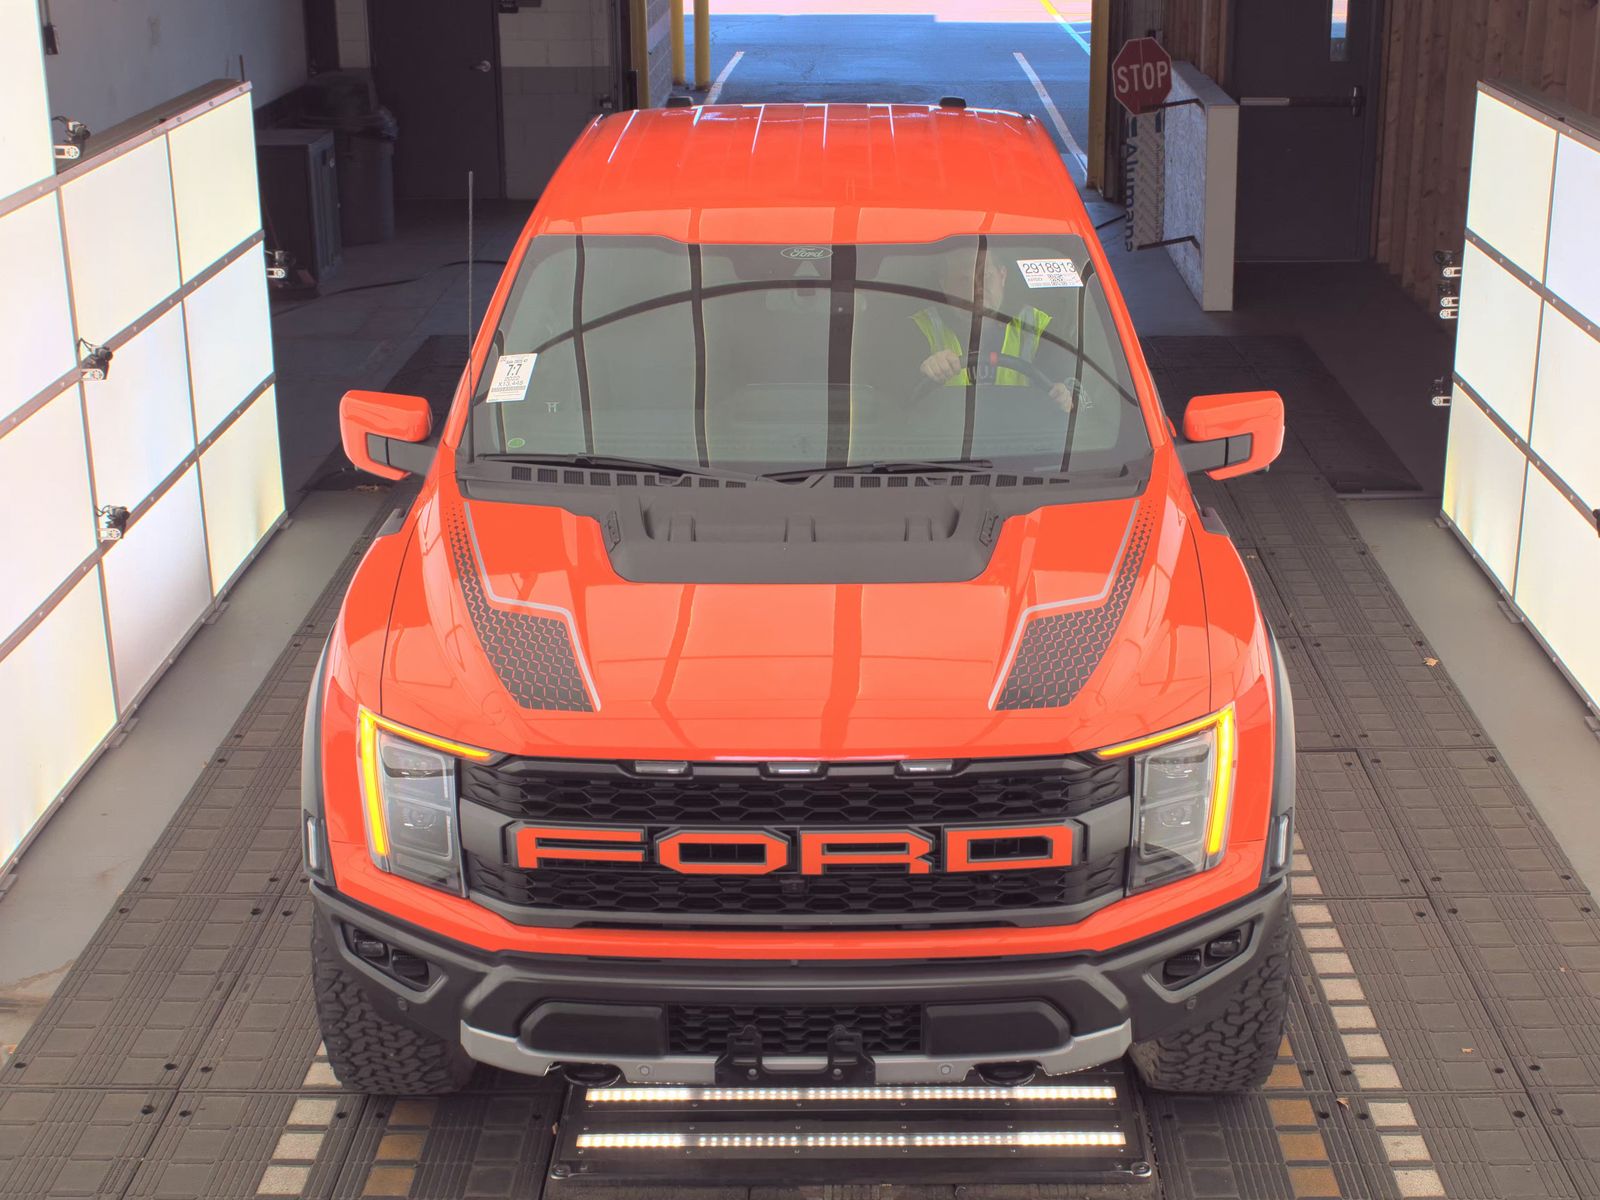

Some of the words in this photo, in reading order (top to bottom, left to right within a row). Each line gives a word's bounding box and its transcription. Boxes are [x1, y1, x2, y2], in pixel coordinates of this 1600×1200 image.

[1117, 61, 1168, 93] STOP
[1022, 262, 1077, 274] 2918913
[515, 823, 1075, 876] FORD
